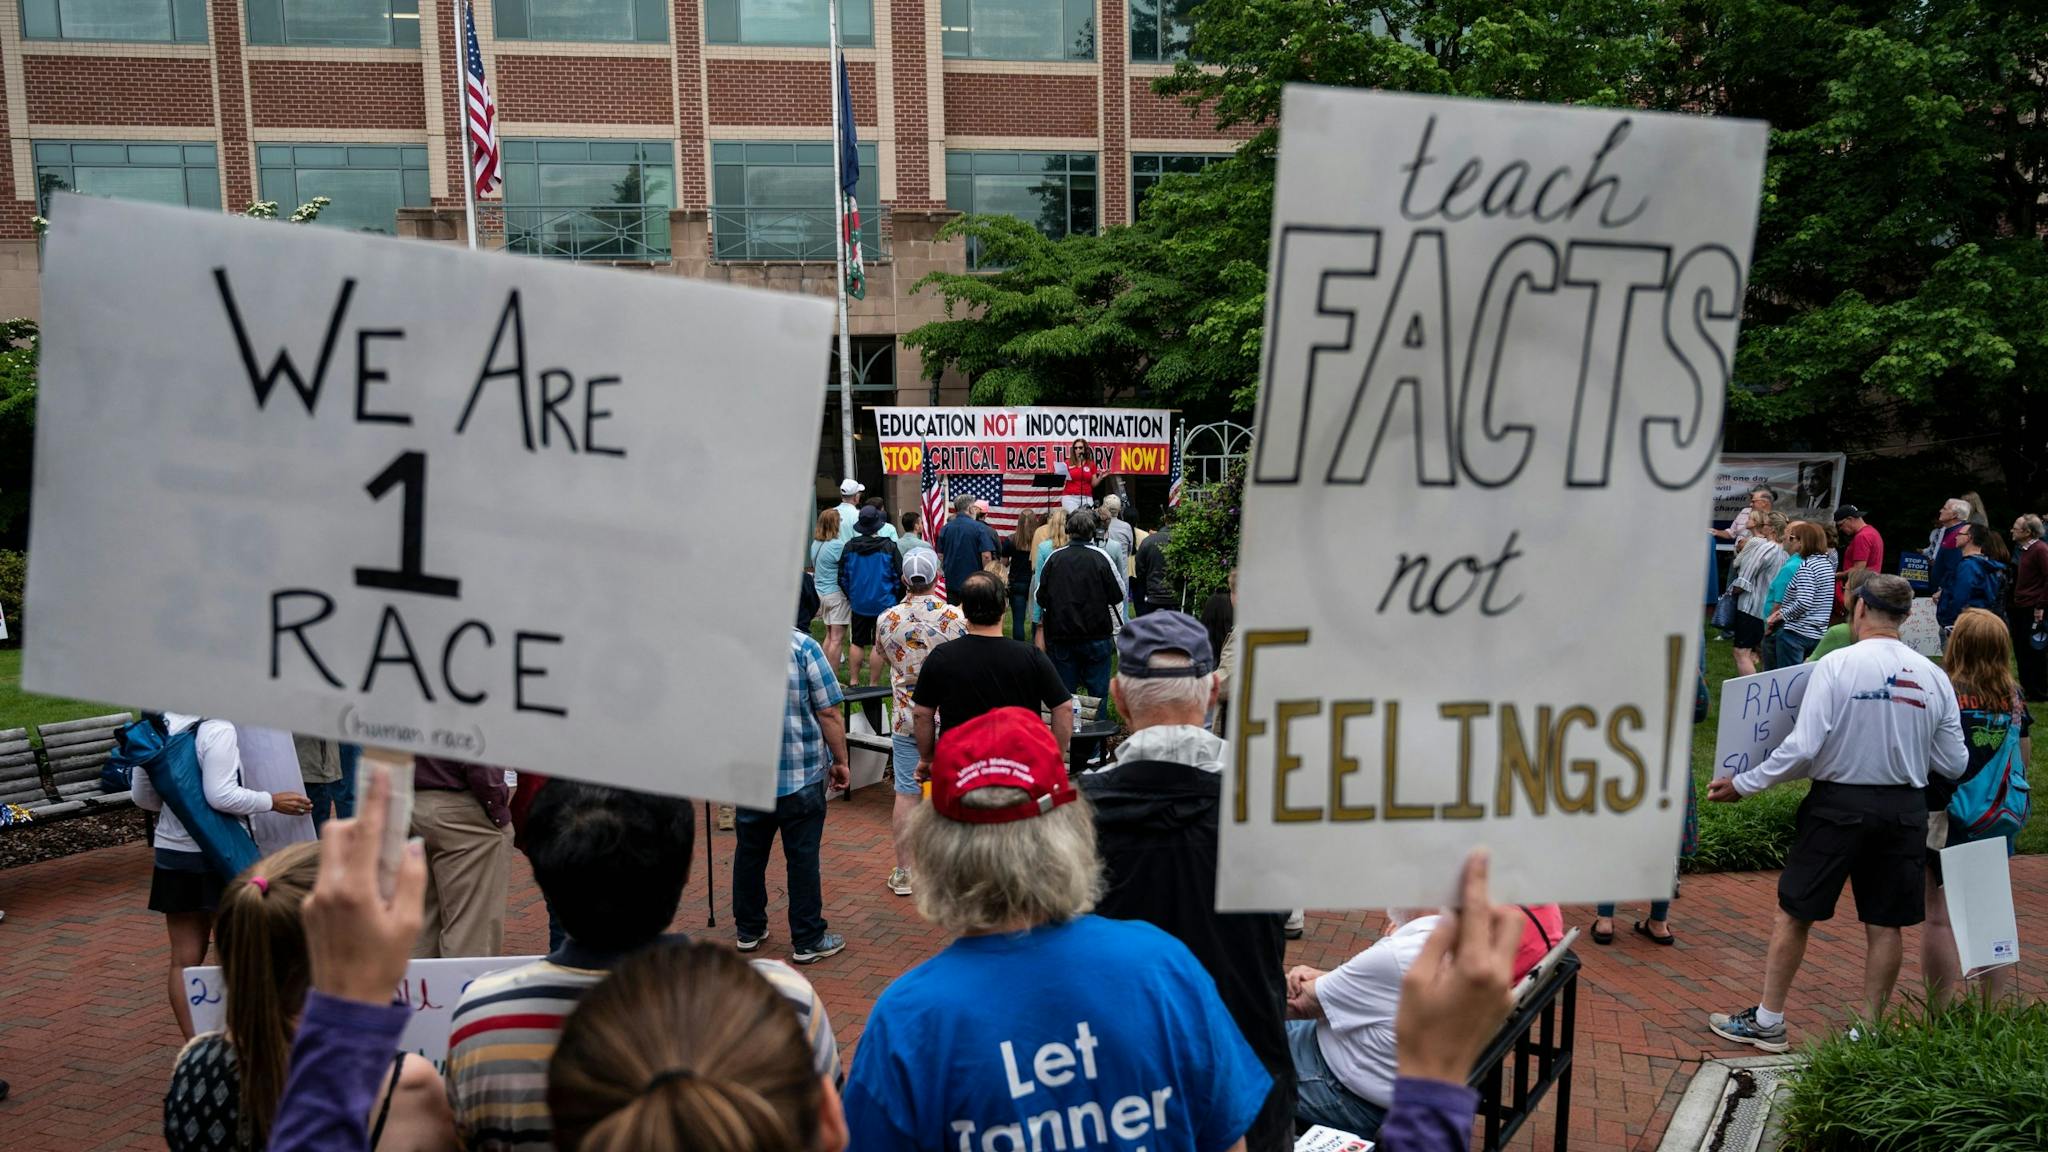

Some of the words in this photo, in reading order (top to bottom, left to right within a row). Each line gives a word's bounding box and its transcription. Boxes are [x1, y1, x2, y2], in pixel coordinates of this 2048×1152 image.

[1399, 113, 1652, 228] teach
[211, 266, 412, 427] WE
[456, 287, 628, 458] ARE
[1253, 225, 1743, 490] FACTS
[879, 413, 976, 437] EDUCATION
[983, 414, 1018, 437] NOT
[1026, 414, 1163, 438] INDOCTRINATION
[882, 446, 922, 472] STOP
[930, 446, 1000, 471] CRITICAL
[1006, 446, 1048, 470] RACE
[1053, 446, 1115, 470] THORY
[1752, 475, 1769, 483] day
[354, 450, 461, 598] 1
[1376, 530, 1524, 616] not
[270, 589, 568, 717] RACE
[1234, 627, 1684, 823] FEELINGS!
[1743, 672, 1804, 719] RAC
[1754, 721, 1770, 742] IS
[1000, 1021, 1098, 1099] Let
[951, 1086, 1172, 1152] Tanner
